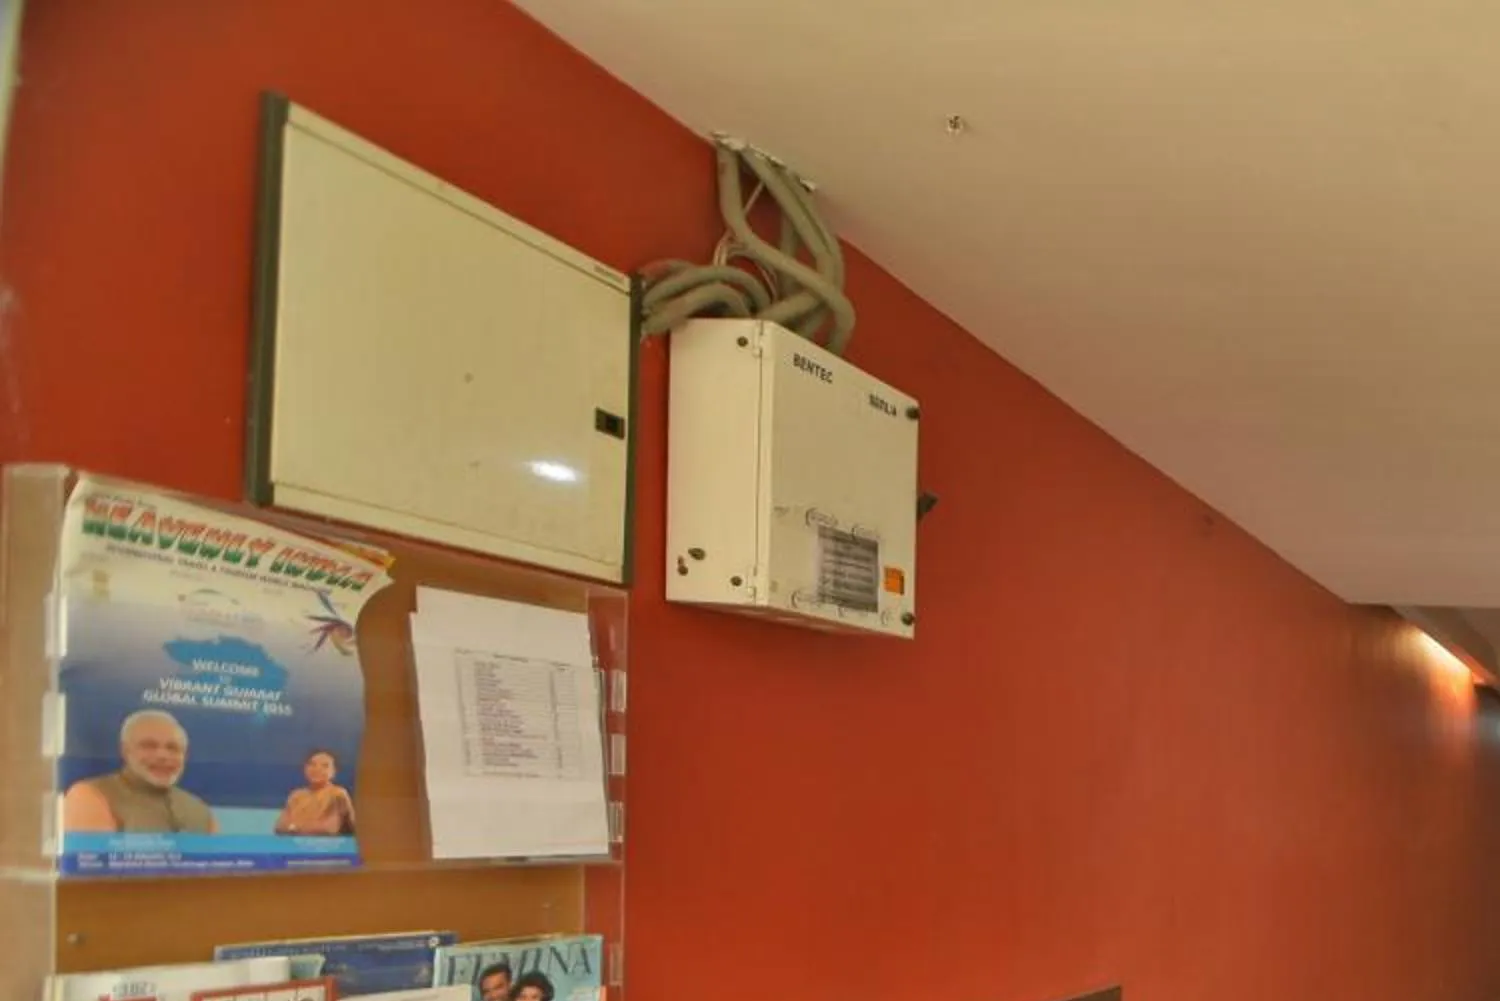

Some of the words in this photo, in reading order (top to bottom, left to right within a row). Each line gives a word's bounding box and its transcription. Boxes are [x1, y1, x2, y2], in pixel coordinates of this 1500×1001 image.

[793, 352, 833, 384] BENTEC
[192, 658, 260, 677] WELCOME
[159, 675, 220, 694] VIBRANT
[142, 688, 198, 706] GLOBAL
[201, 696, 258, 712] SUMMIT
